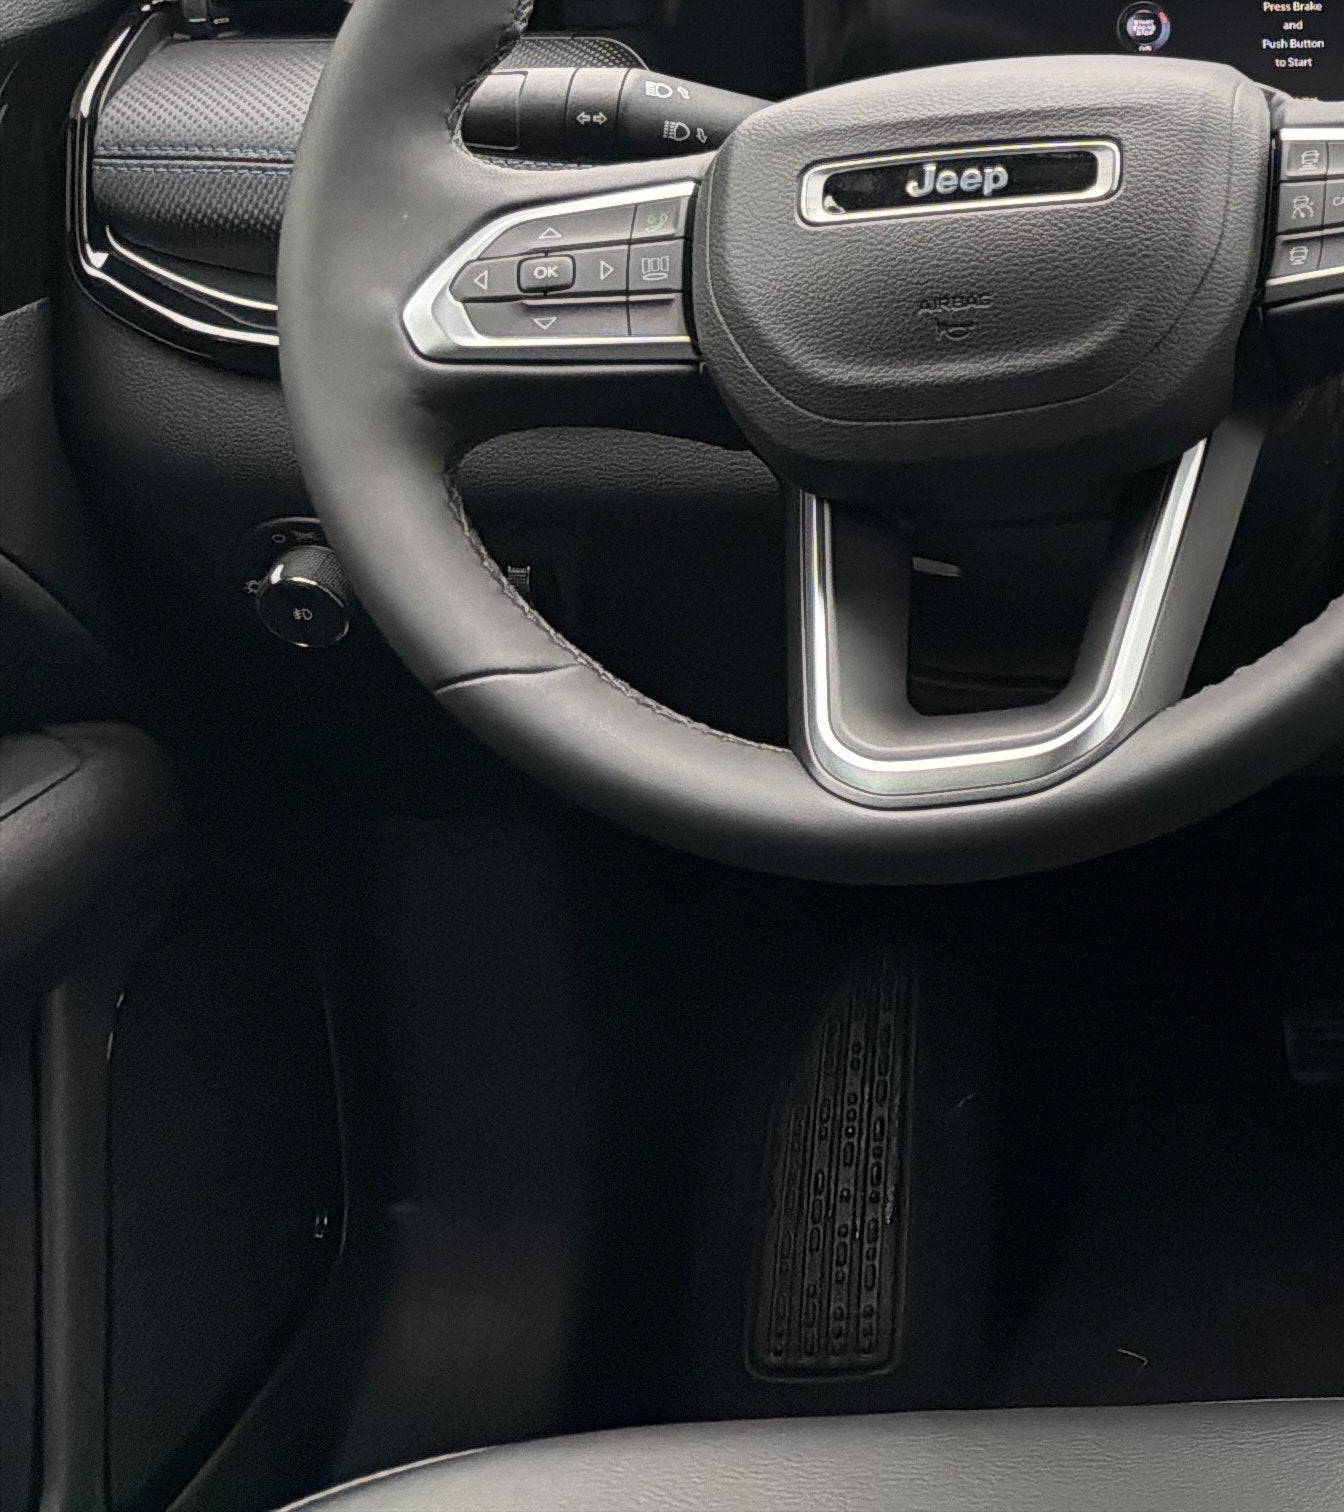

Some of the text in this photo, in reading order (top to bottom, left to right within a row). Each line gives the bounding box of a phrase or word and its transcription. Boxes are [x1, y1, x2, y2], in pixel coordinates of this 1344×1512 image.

[1263, 0, 1323, 12] Press Brake
[1283, 19, 1303, 30] and
[1262, 38, 1325, 49] Push Button
[1275, 57, 1313, 68] to Start
[905, 161, 1009, 198] Jeep
[533, 265, 559, 279] OK
